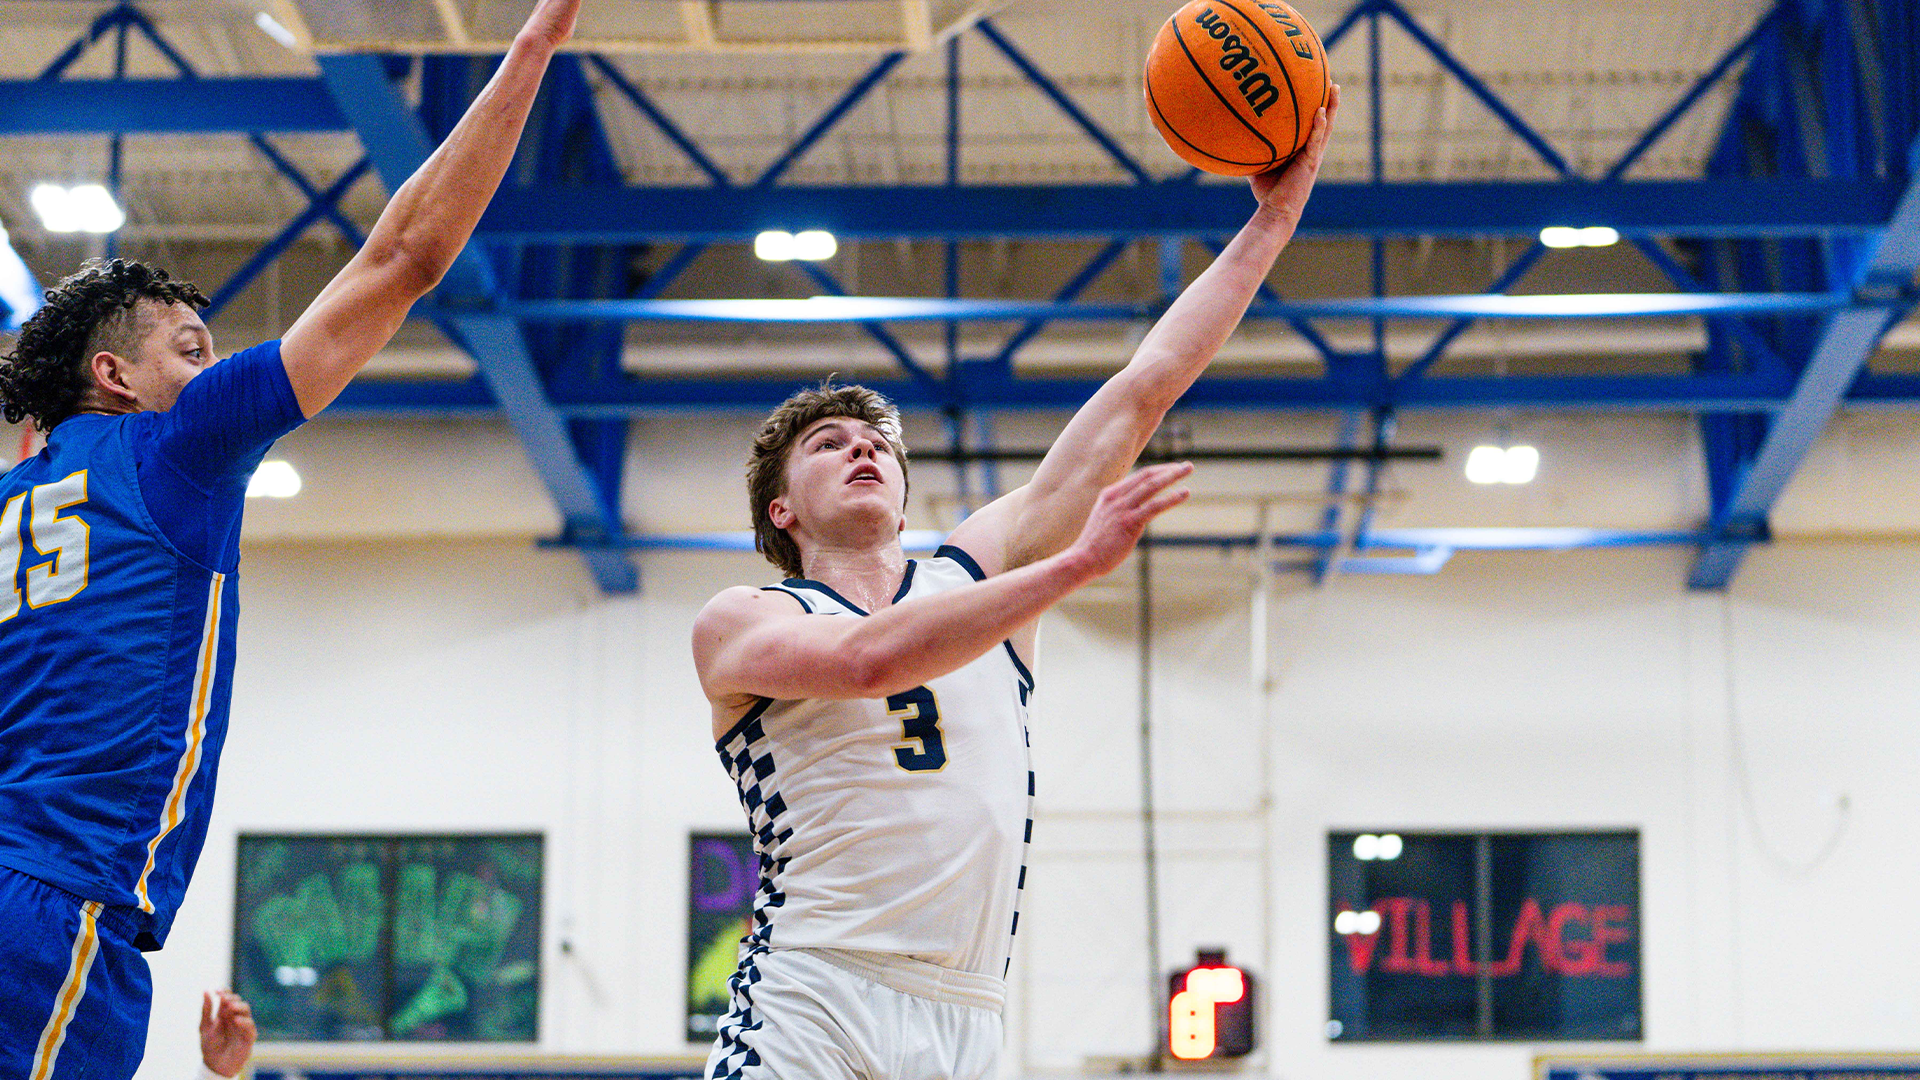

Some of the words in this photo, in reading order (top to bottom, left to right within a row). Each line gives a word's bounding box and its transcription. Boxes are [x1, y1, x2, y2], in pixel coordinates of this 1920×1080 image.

[1195, 7, 1280, 118] Wilson
[1258, 3, 1314, 60] EVO
[0, 469, 91, 624] 15
[885, 684, 950, 774] 3
[1336, 898, 1630, 977] VILLAGE
